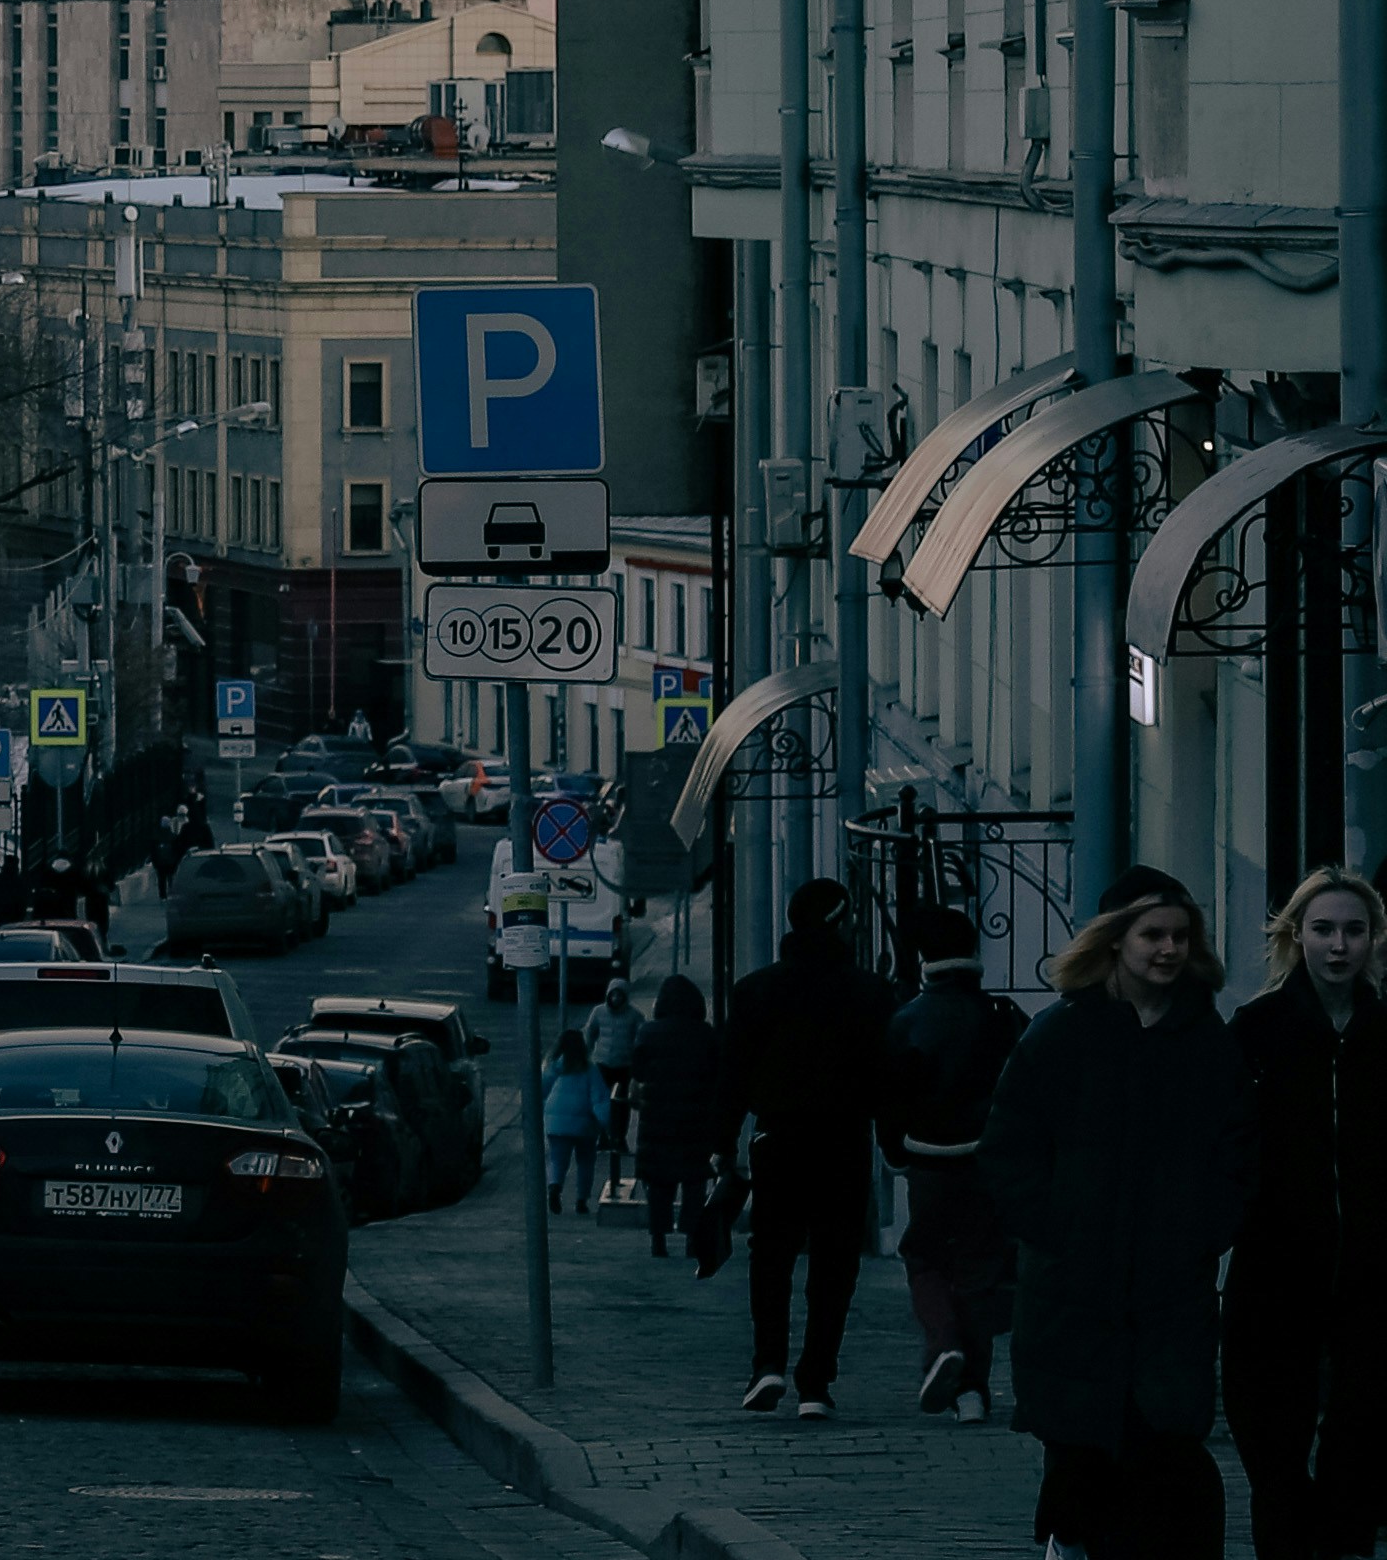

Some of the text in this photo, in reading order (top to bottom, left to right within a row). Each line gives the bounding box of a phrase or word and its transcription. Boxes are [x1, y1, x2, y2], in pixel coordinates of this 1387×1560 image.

[465, 312, 557, 449] P
[448, 616, 592, 655] 10 15 20
[226, 686, 246, 714] P
[660, 674, 677, 698] P
[143, 1185, 176, 1204] 777
